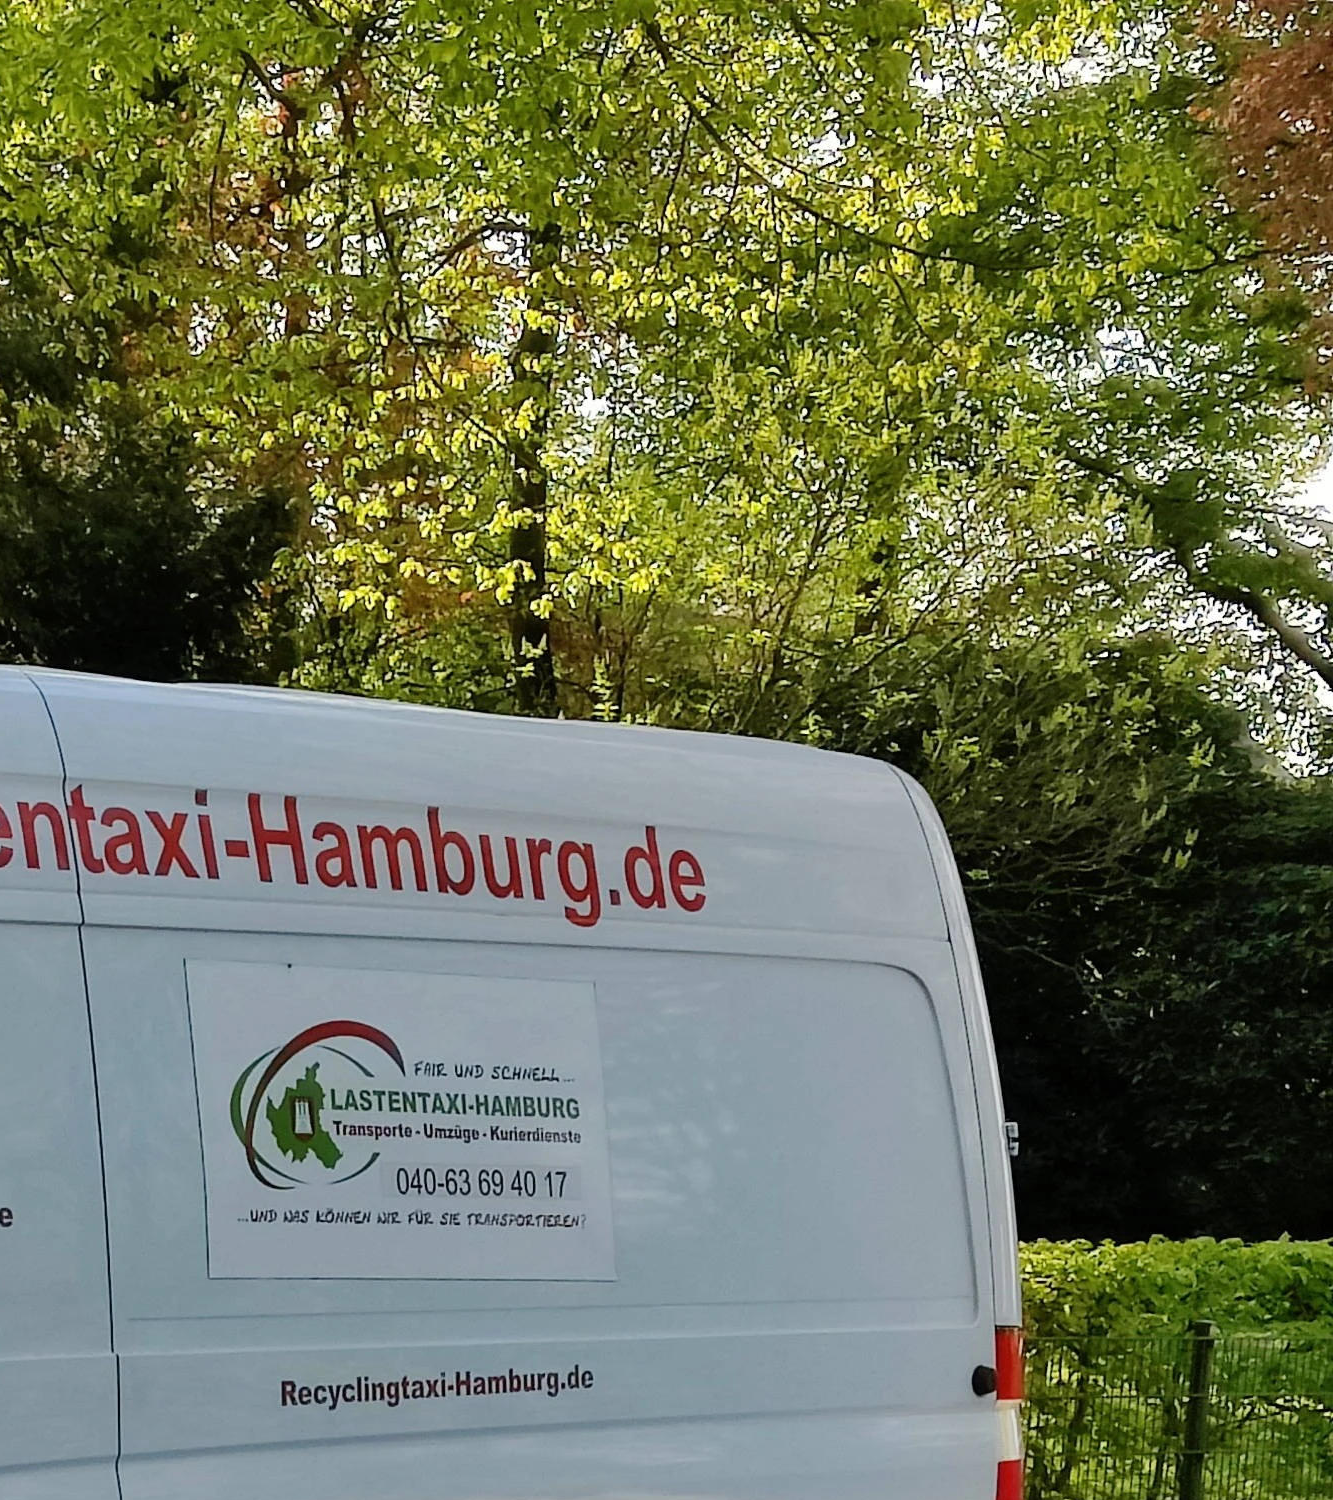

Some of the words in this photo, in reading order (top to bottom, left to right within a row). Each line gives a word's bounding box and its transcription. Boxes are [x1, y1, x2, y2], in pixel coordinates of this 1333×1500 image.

[413, 1061, 448, 1077] FAIR
[454, 1063, 484, 1079] UND
[329, 1088, 581, 1119] LASTENTAXI-HAMBURG
[332, 1120, 413, 1140] Transporte
[423, 1123, 480, 1144] Umzüge
[489, 1125, 582, 1144] Kurierdienste
[396, 1167, 471, 1196] 040-63
[478, 1169, 504, 1196] 69
[511, 1170, 536, 1197] 40
[544, 1171, 567, 1198] 17
[283, 1210, 310, 1224] WAS
[316, 1208, 371, 1225] KÖNNEN
[376, 1211, 402, 1225] WIR
[407, 1209, 434, 1226] FÜR
[439, 1212, 462, 1226] SIE
[467, 1212, 587, 1229] TRANSPORTIEREN?
[280, 1364, 595, 1411] Recyclingtaxi-Hamburg.de
